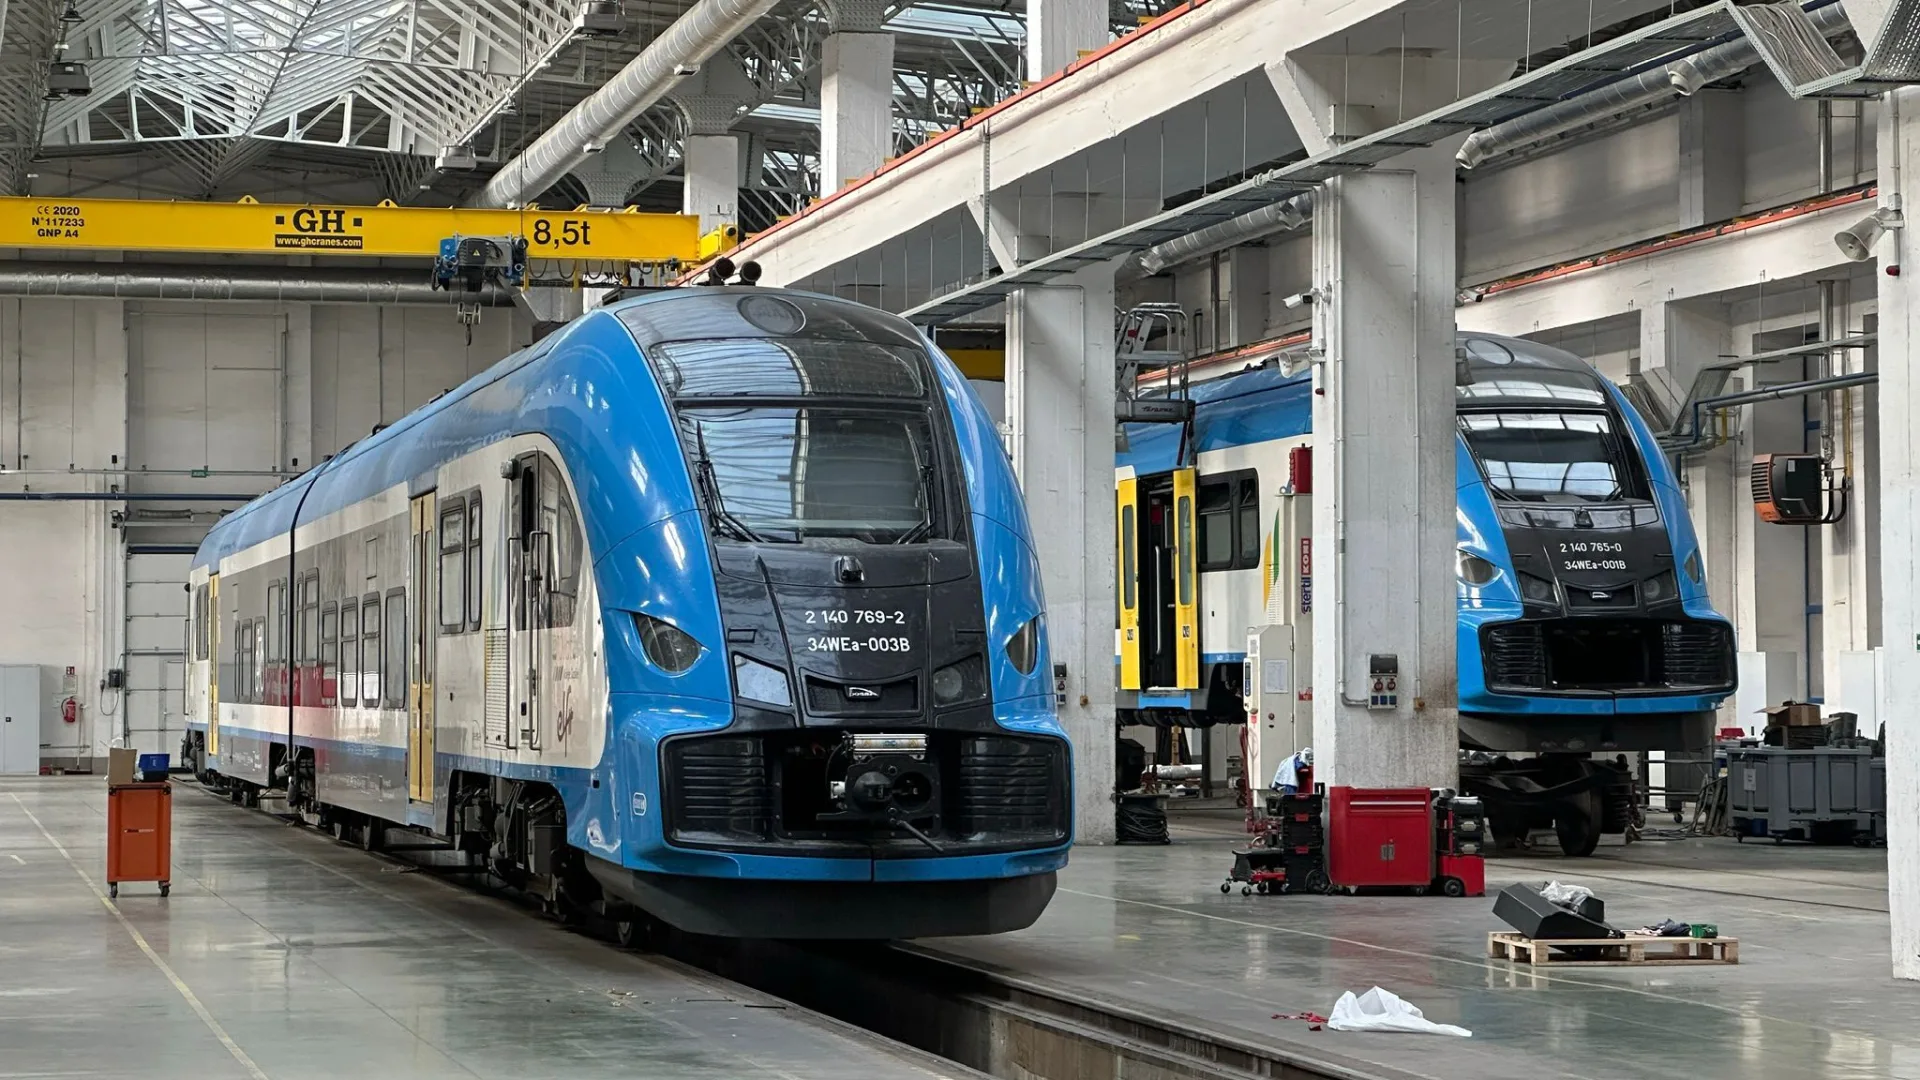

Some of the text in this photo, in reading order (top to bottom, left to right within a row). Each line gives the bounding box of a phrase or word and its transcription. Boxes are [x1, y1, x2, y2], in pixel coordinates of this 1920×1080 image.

[53, 206, 80, 216] 2020
[293, 208, 345, 233] GH
[37, 228, 79, 238] GNP A4
[533, 219, 591, 249] 8,5t
[276, 236, 362, 247] www.ghcranes.com
[1560, 542, 1622, 553] 2 140 765-0
[1564, 560, 1627, 570] 34WEa-001B
[1300, 577, 1312, 615] stertil
[805, 610, 906, 625] 2 140 769-2
[807, 637, 911, 652] 34WEa-003B
